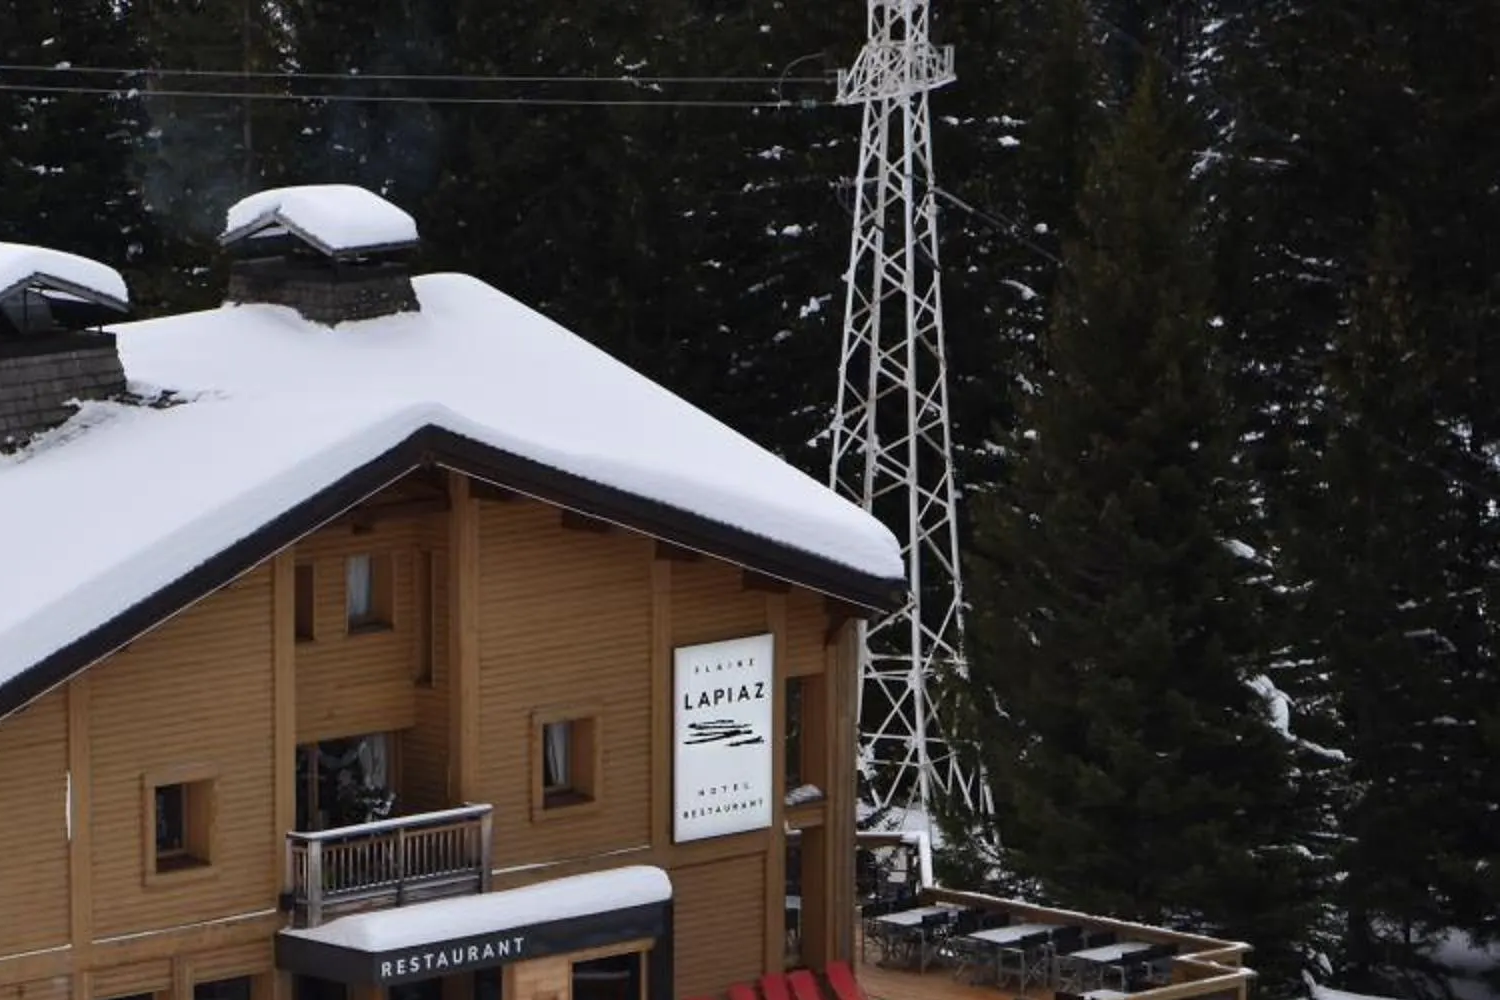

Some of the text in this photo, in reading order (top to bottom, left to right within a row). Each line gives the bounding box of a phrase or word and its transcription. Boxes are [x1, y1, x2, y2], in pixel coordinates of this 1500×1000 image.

[684, 682, 764, 710] LAPIAZ
[698, 781, 751, 796] HOTEL
[683, 797, 763, 819] RESTAURANT
[381, 937, 525, 978] RESTAURANT
